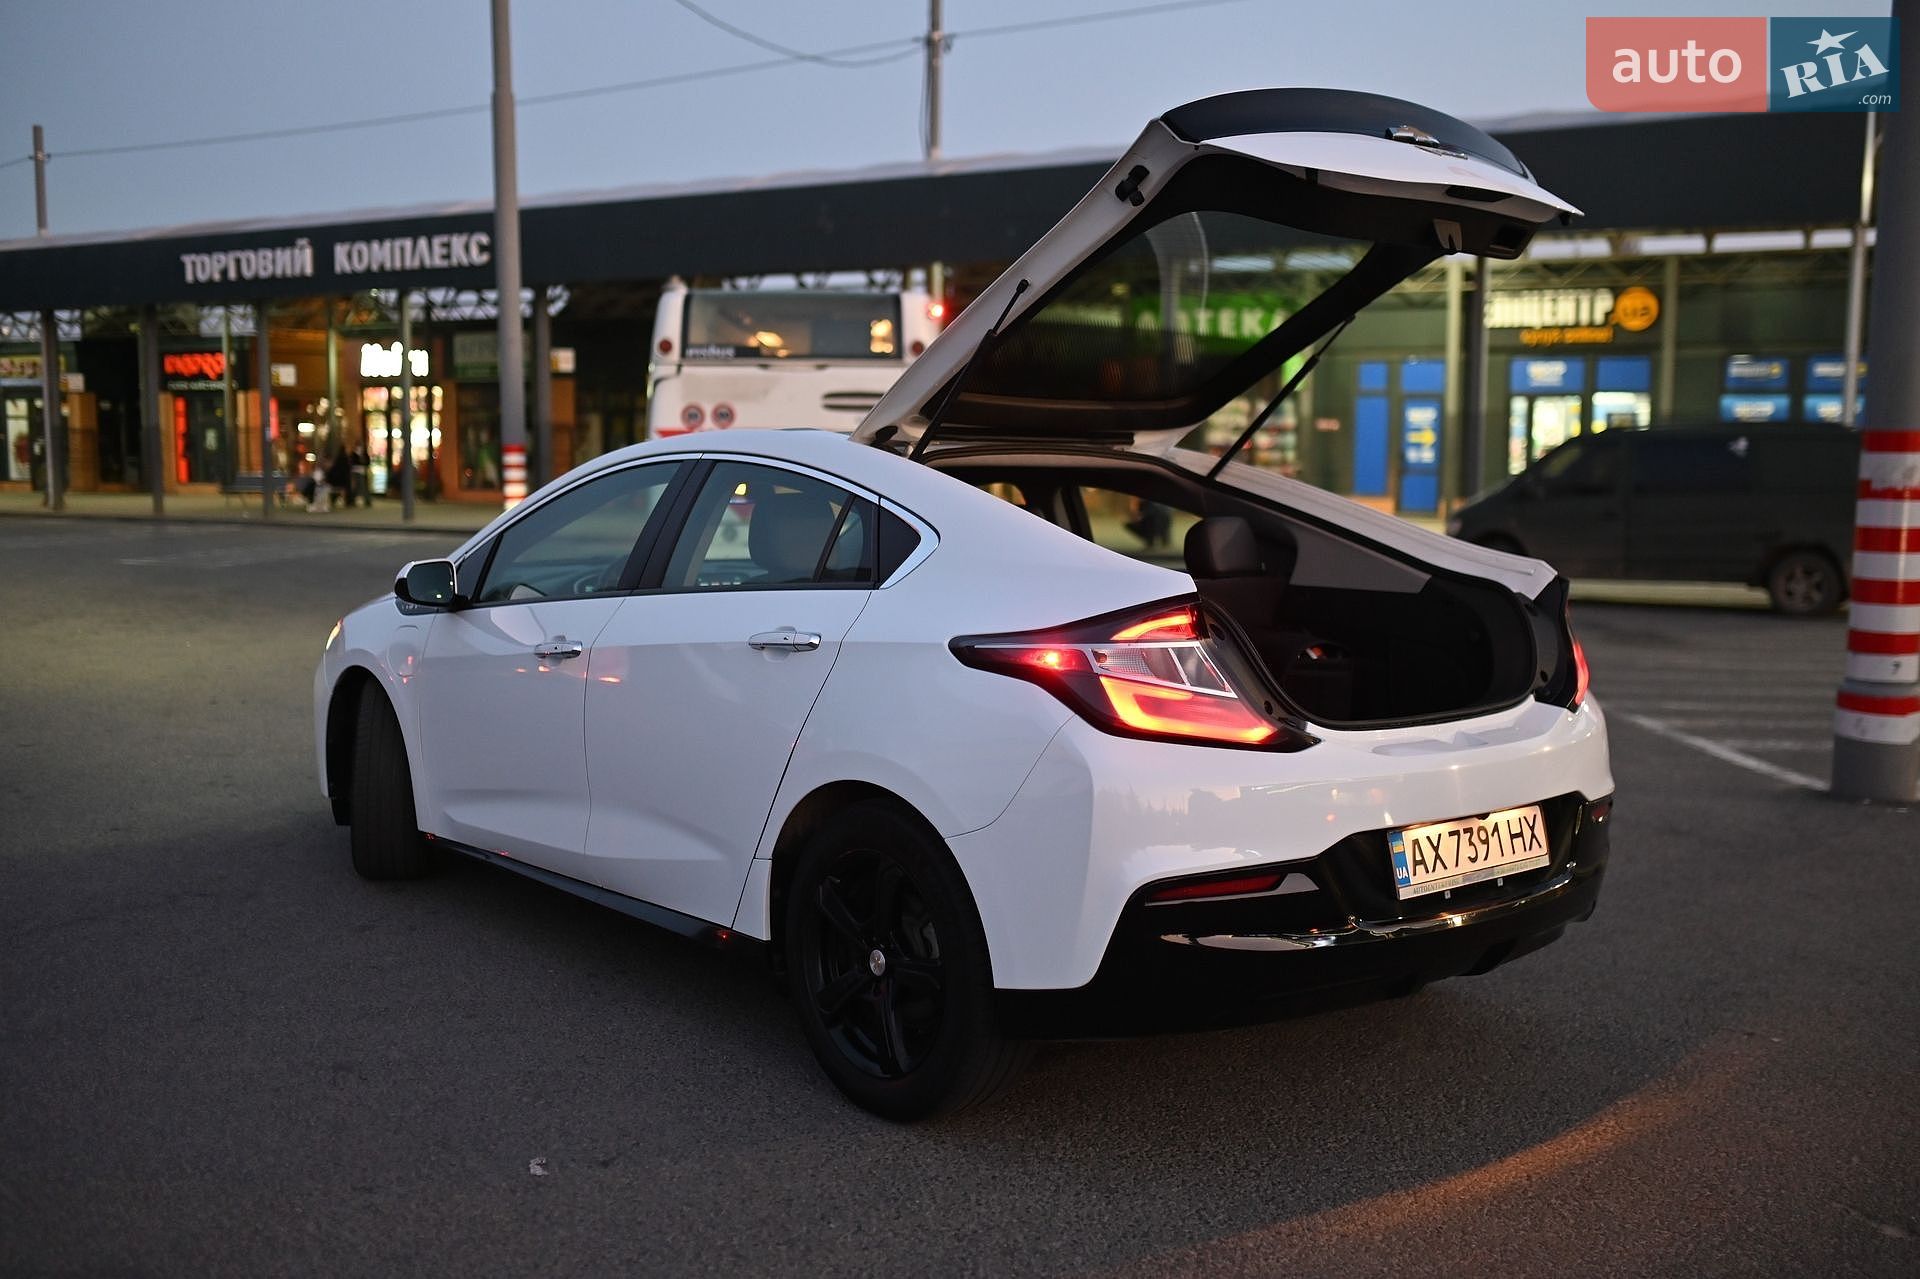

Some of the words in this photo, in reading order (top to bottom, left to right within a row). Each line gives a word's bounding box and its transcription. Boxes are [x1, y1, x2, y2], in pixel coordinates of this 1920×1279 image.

[180, 238, 314, 284] ТОРГОВИЙ
[333, 231, 491, 275] КОМПЛЕКС
[1411, 833, 1448, 876] AX
[1448, 822, 1505, 868] 7391
[1507, 814, 1542, 854] HX
[1396, 867, 1409, 880] UA
